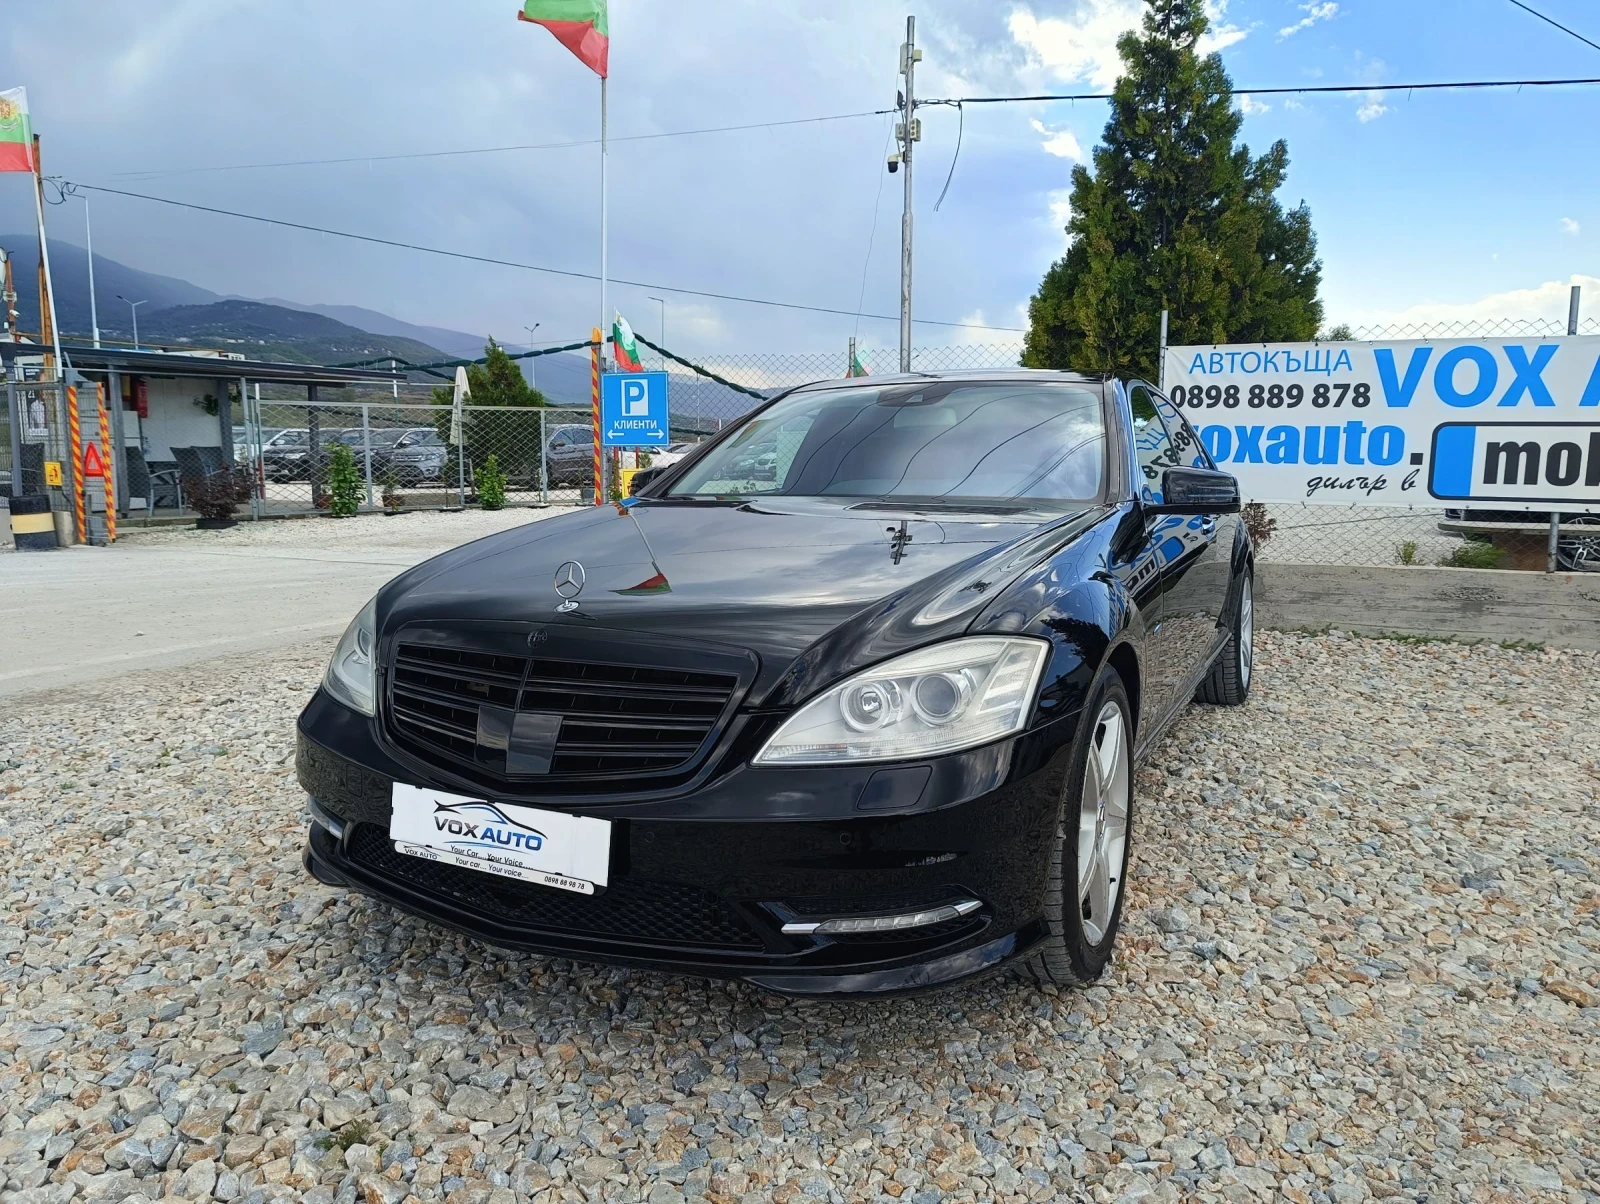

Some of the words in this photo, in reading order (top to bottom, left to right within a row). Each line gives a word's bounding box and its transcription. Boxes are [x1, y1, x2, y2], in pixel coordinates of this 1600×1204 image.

[1189, 348, 1353, 376] АВТОКЪЩА
[1373, 344, 1560, 408] VOX
[624, 380, 645, 414] P
[1170, 384, 1240, 409] 0898
[1247, 383, 1304, 409] 889
[1312, 382, 1371, 408] 878
[614, 419, 658, 430] КЛИЕНТИ
[1195, 420, 1423, 466] oxauto.
[1306, 475, 1388, 497] дилър
[434, 816, 480, 838] VOX
[480, 827, 543, 851] AUTO
[404, 848, 418, 856] VOX
[419, 851, 438, 860] AUTO
[450, 844, 465, 854] Your
[455, 856, 469, 866] Your
[488, 863, 503, 873] Your
[544, 875, 559, 885] 0898
[560, 878, 568, 887] 88
[568, 880, 577, 888] 98
[577, 882, 585, 890] 78
